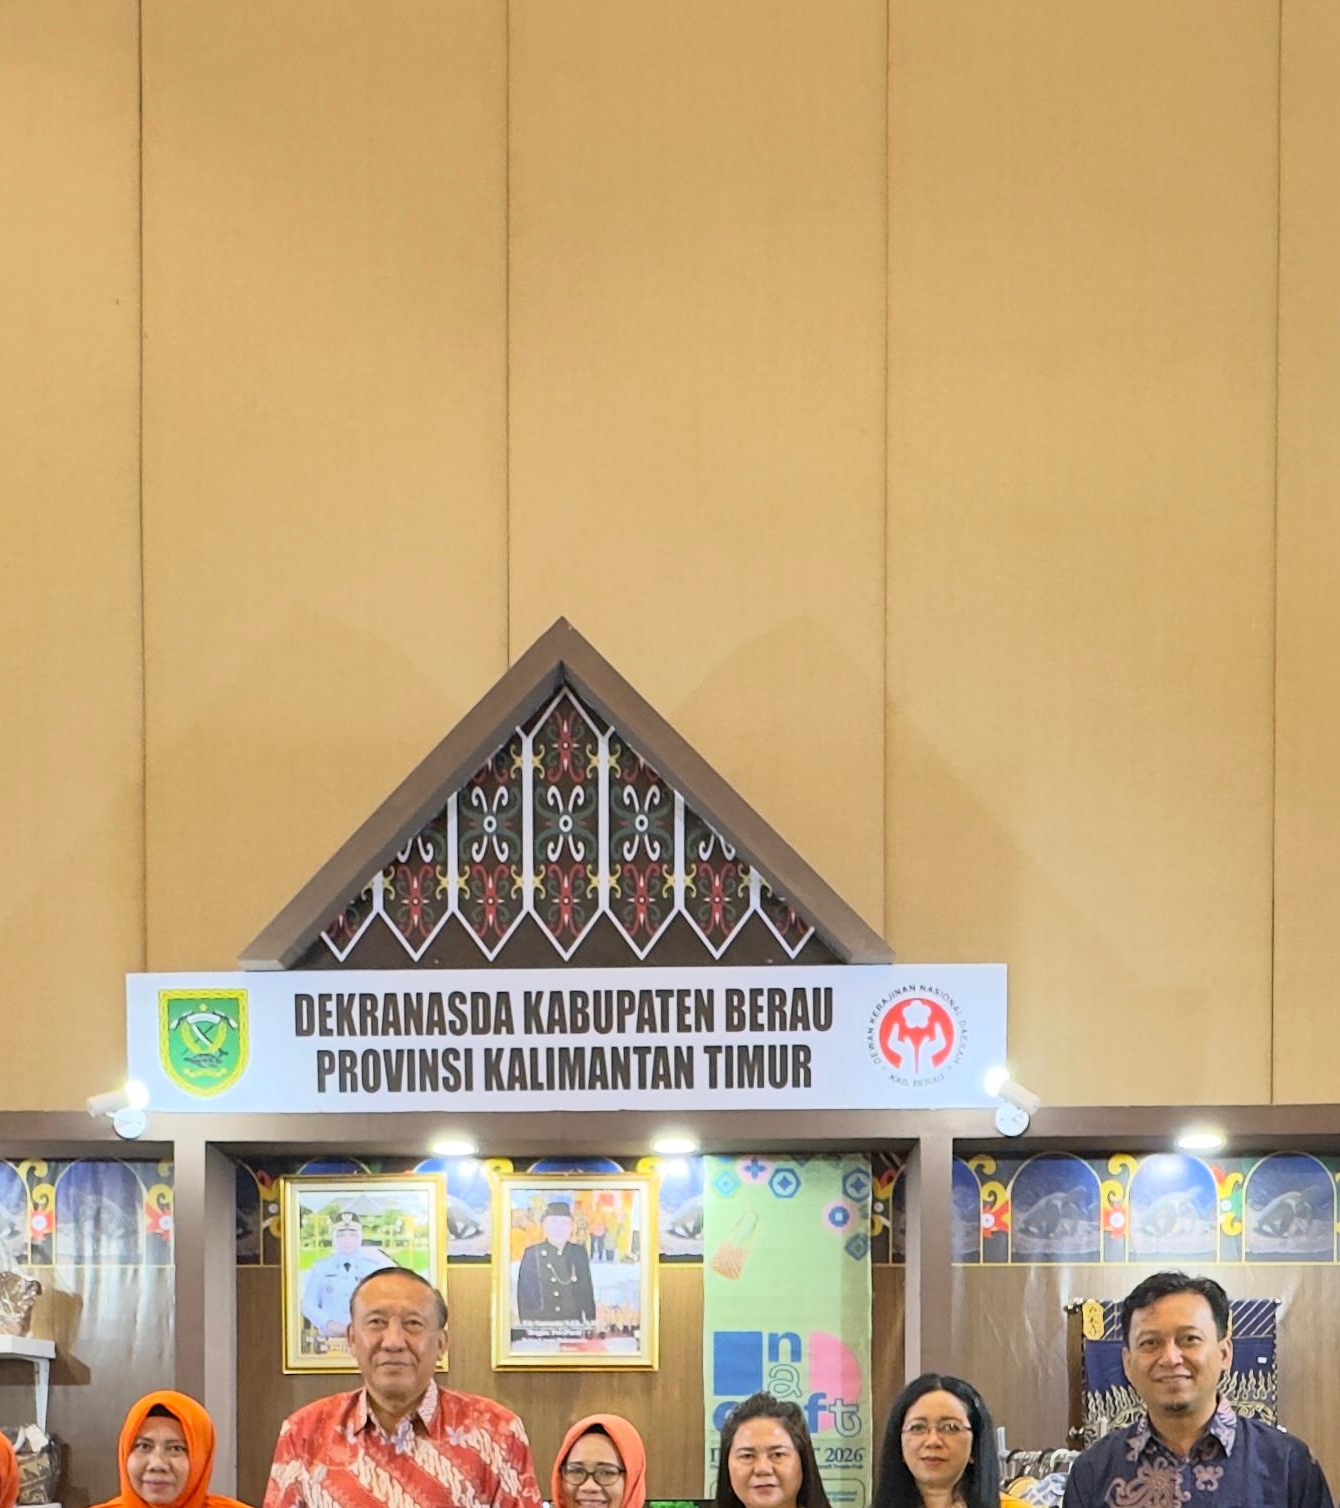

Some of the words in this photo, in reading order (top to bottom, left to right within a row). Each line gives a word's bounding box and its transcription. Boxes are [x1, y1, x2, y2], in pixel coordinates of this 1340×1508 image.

[294, 991, 515, 1037] DEKRANASDA
[523, 988, 715, 1035] KABUPATEN
[725, 987, 833, 1033] BERAU
[317, 1047, 474, 1094] PROVINSI
[484, 1046, 694, 1092] KALIMANTAN
[703, 1044, 812, 1090] TIMUR
[825, 1447, 866, 1463] 2026
